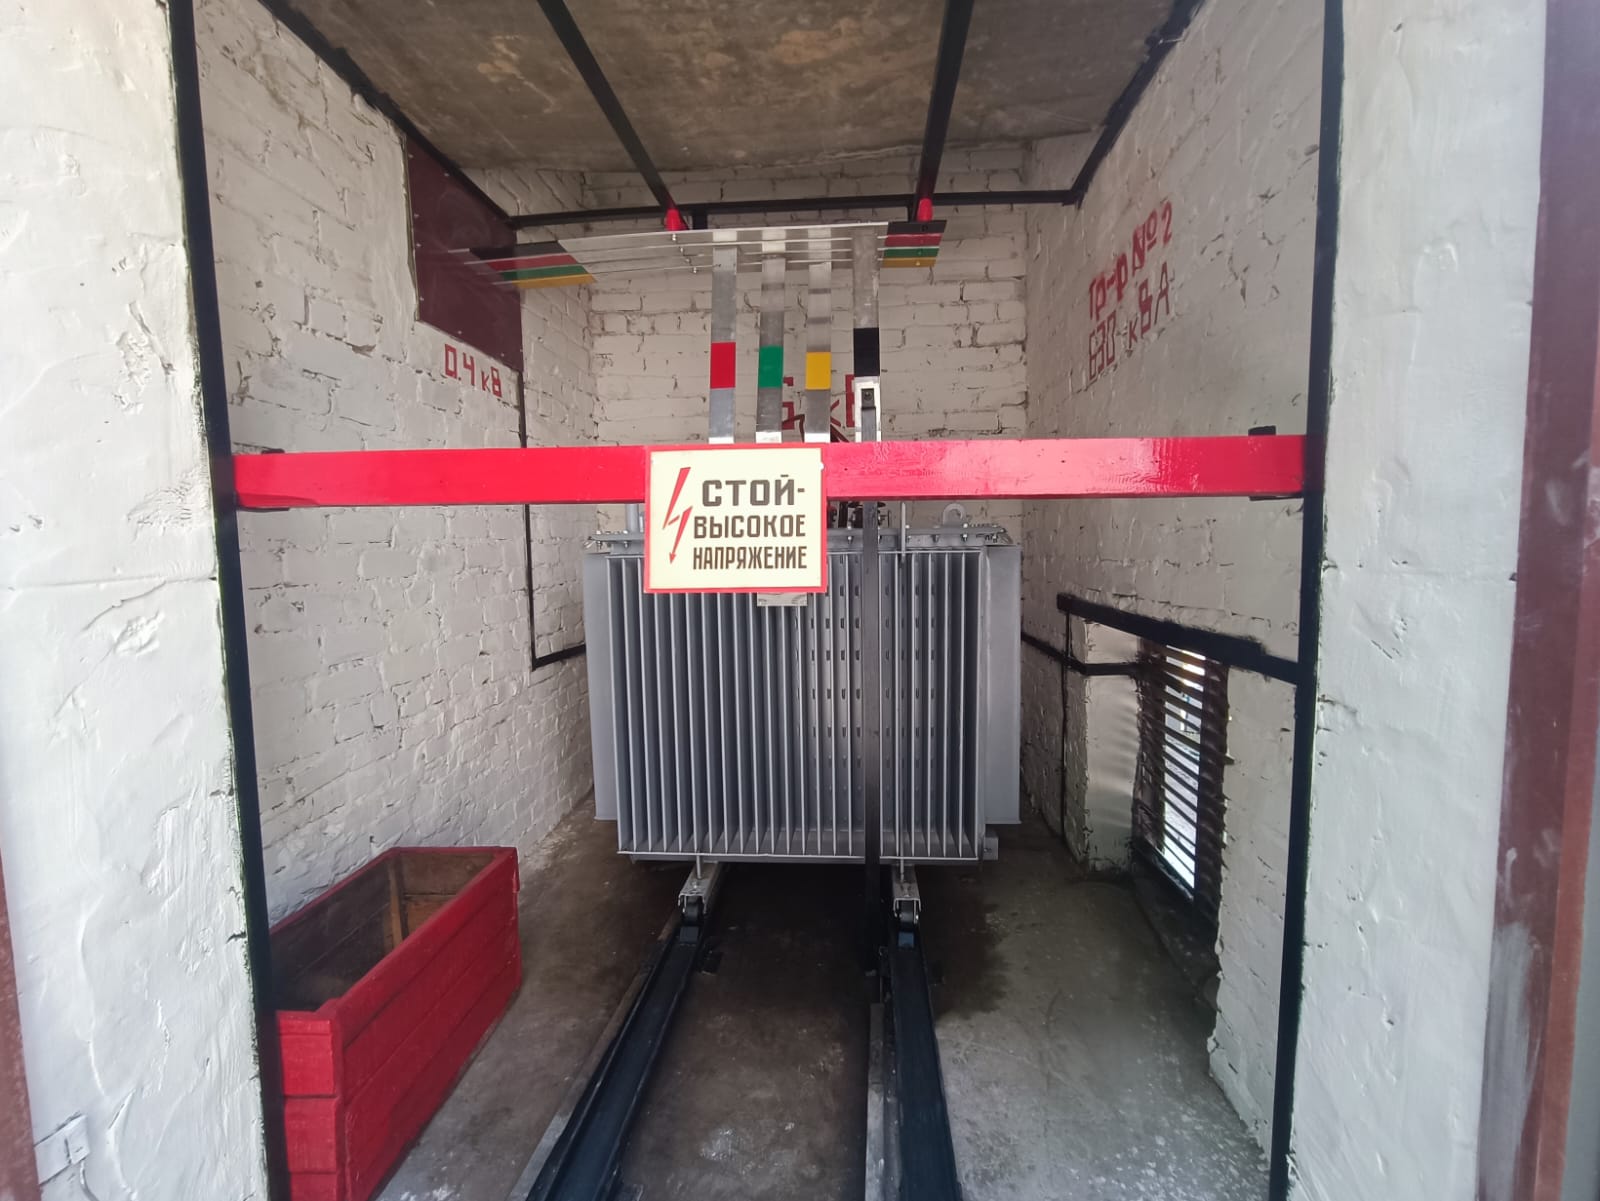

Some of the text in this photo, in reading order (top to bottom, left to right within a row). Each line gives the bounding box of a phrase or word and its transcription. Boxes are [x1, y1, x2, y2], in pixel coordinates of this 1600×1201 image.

[1088, 310, 1117, 381] 630
[693, 514, 806, 539] ВЫСОКОЕ
[692, 545, 808, 570] НАПРЯЖЕНИЕ
